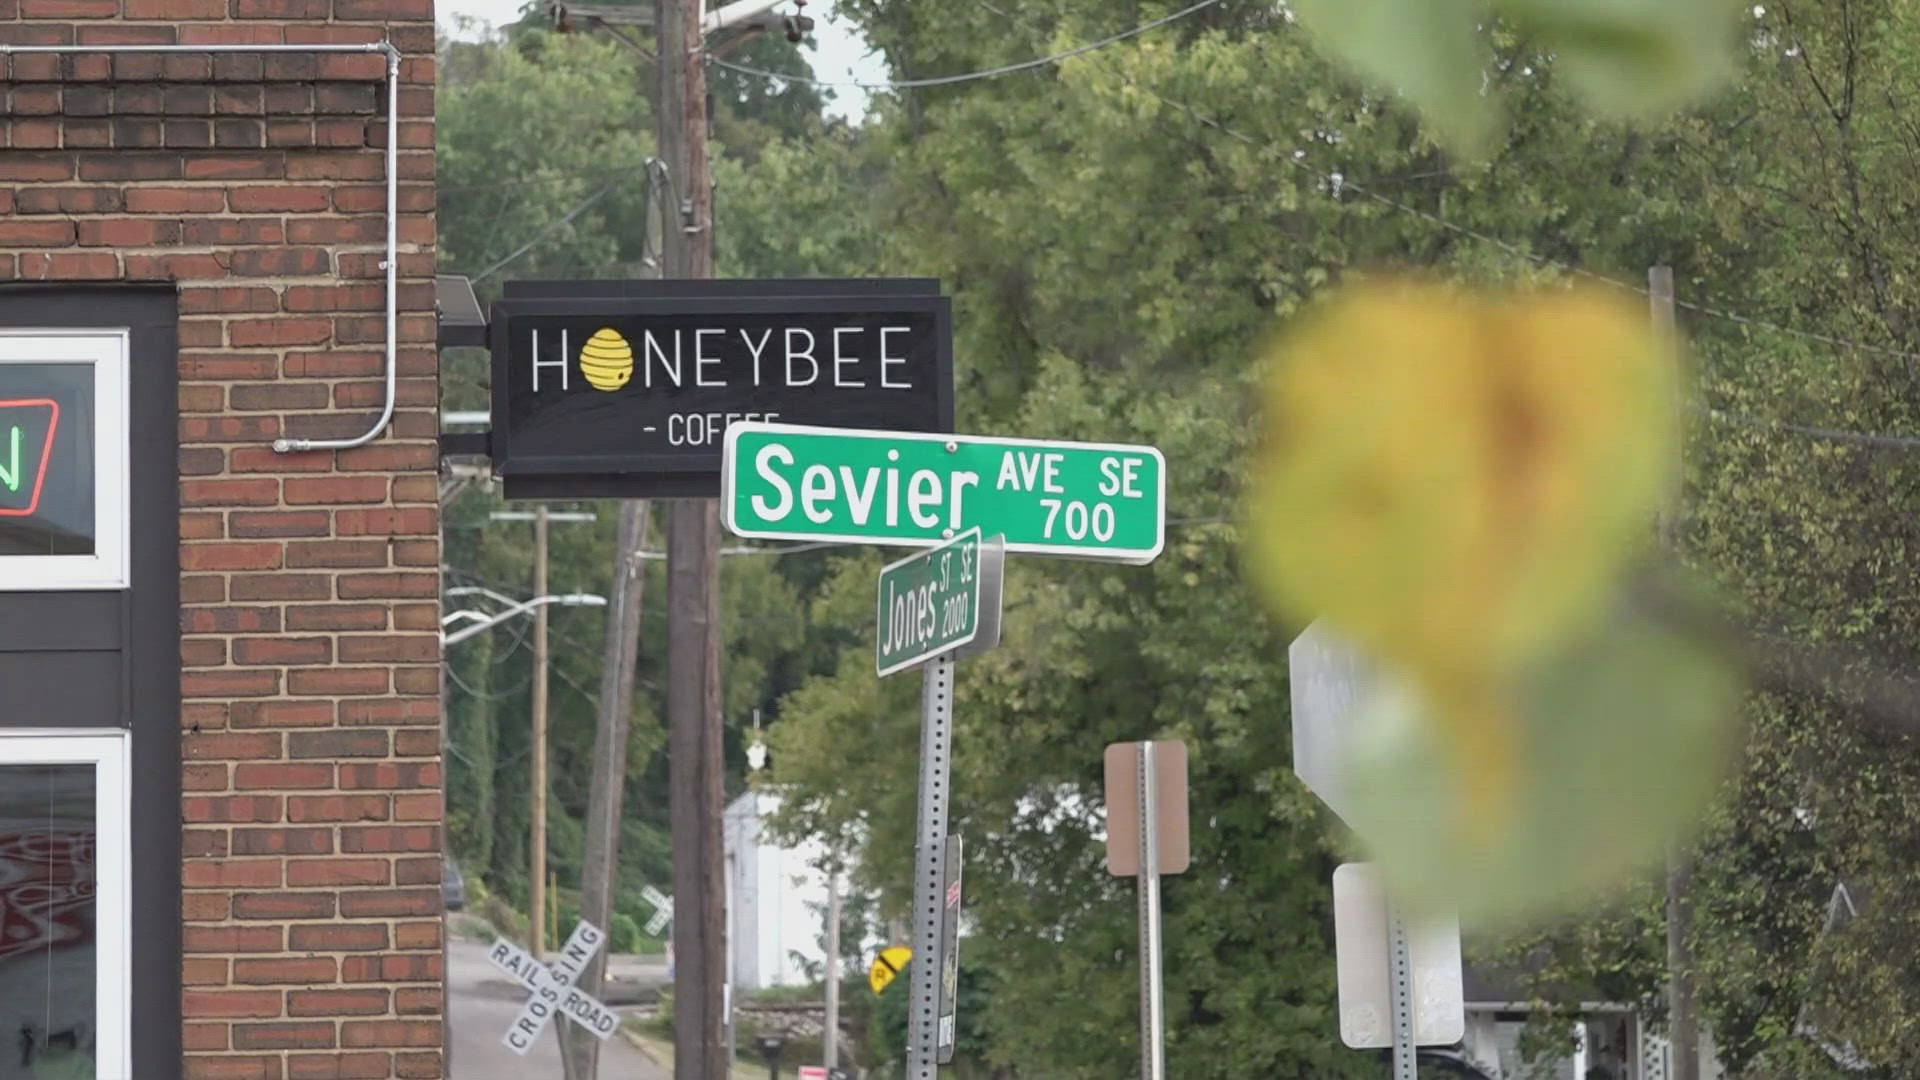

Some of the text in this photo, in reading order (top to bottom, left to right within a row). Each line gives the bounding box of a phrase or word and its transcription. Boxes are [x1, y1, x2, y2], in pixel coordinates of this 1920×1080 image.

[531, 327, 912, 392] HONEYBEE
[668, 413, 780, 446] COF
[751, 443, 1143, 530] Sevier AVE SE
[1039, 499, 1115, 542] 700
[883, 541, 974, 656] Jones ST SE
[942, 592, 968, 638] 2000
[491, 944, 614, 1033] RAIL ROAD
[508, 925, 599, 1050] CROSSING
